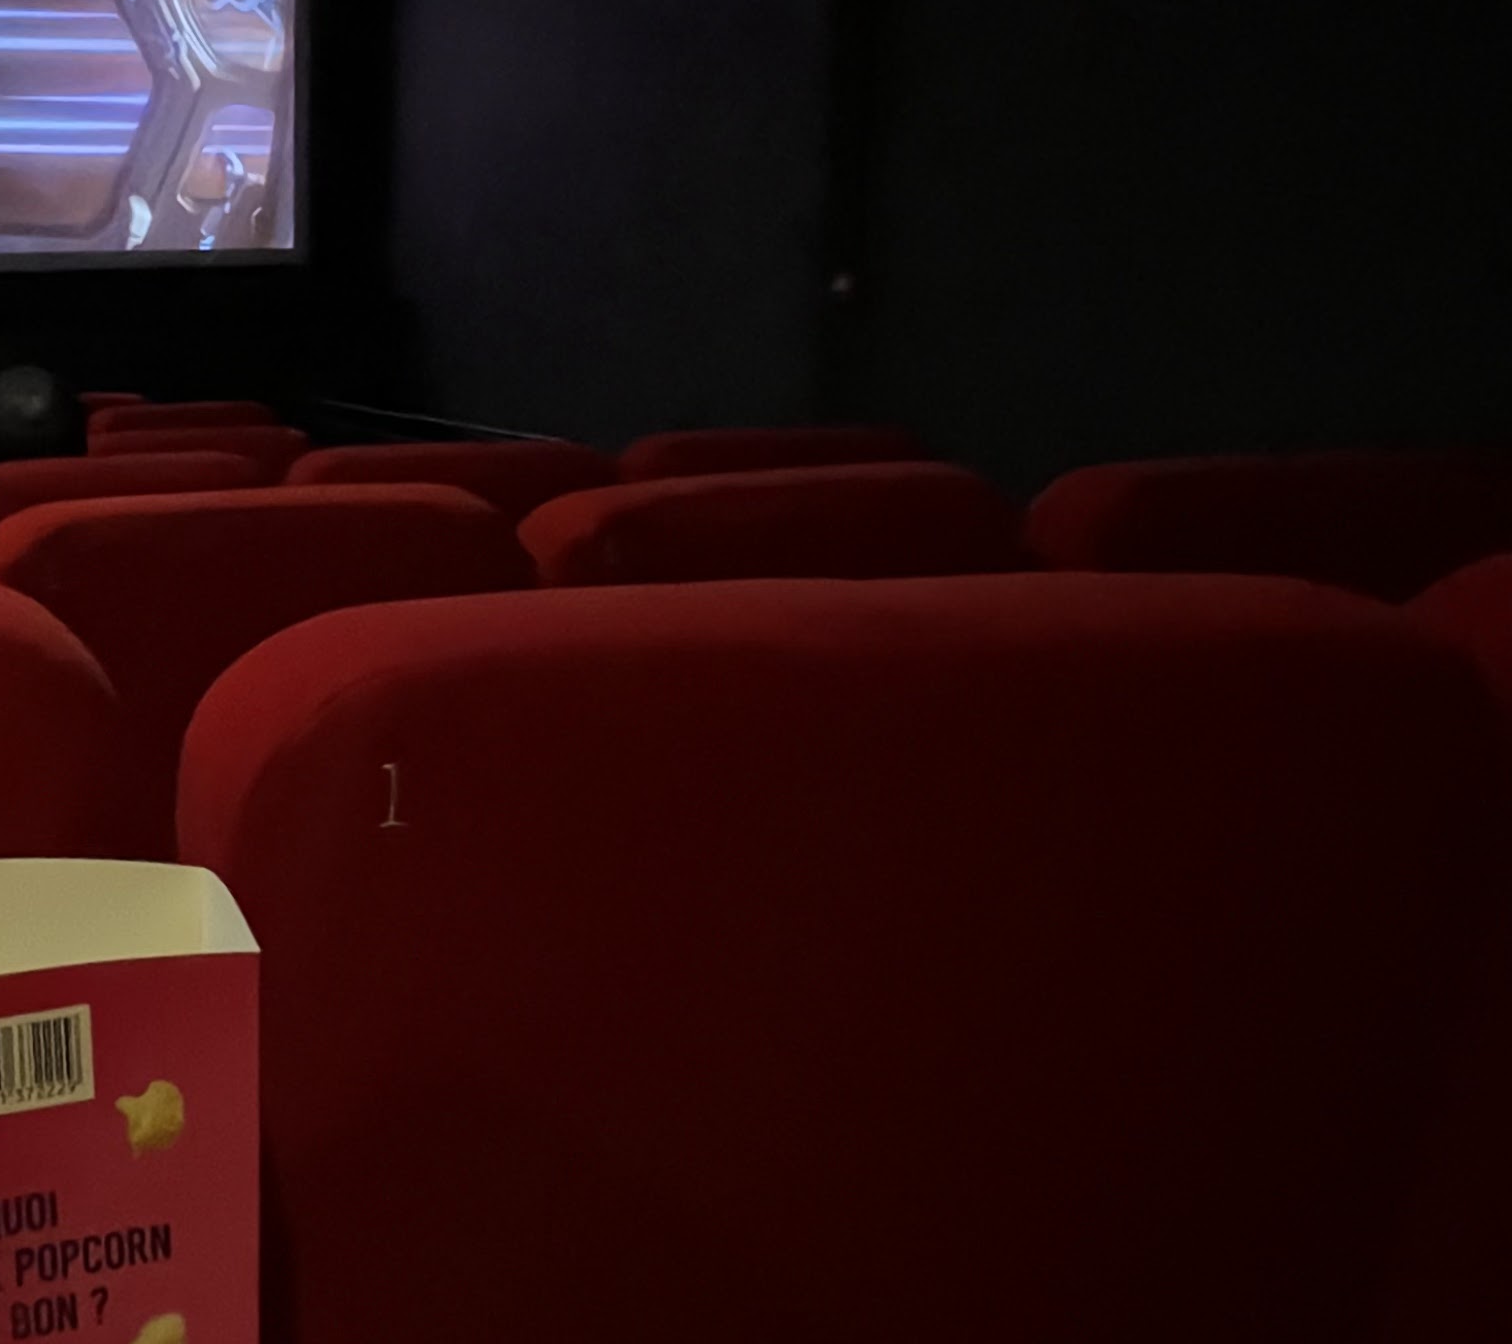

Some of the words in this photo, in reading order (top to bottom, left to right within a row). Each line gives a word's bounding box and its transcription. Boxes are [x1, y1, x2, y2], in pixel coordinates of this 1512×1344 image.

[378, 761, 411, 828] 1
[14, 1223, 171, 1287] POPCORN
[11, 1292, 78, 1340] BON
[90, 1286, 109, 1325] ?
